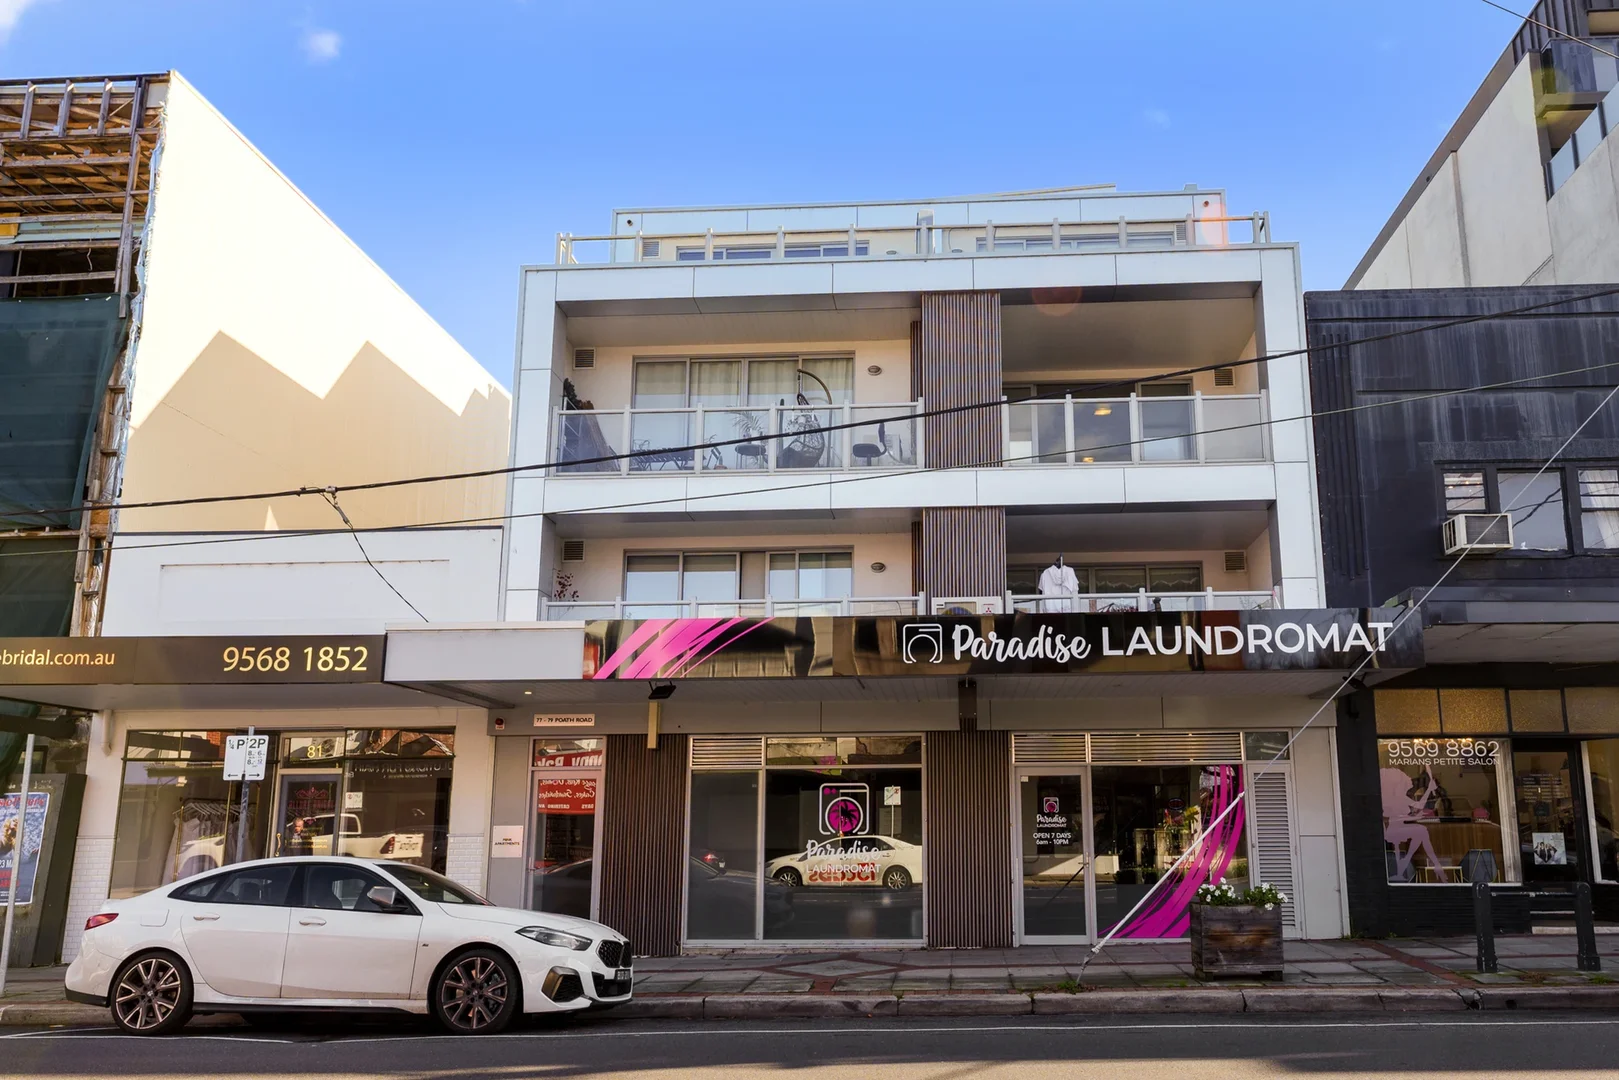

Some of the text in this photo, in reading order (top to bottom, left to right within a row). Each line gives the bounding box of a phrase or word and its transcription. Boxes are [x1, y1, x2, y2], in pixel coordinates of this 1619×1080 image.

[951, 621, 1394, 662] Paradise LAUNDROMAT
[0, 649, 115, 665] bridal.com.au
[223, 646, 368, 672] 9568 1852
[248, 738, 266, 749] 2P
[1388, 740, 1501, 757] 9569 8862
[307, 745, 323, 758] 81
[1389, 758, 1432, 766] MARIANS
[1036, 813, 1067, 823] Paradise
[806, 839, 881, 862] Paradise
[806, 864, 882, 873] LAUNDROMAT
